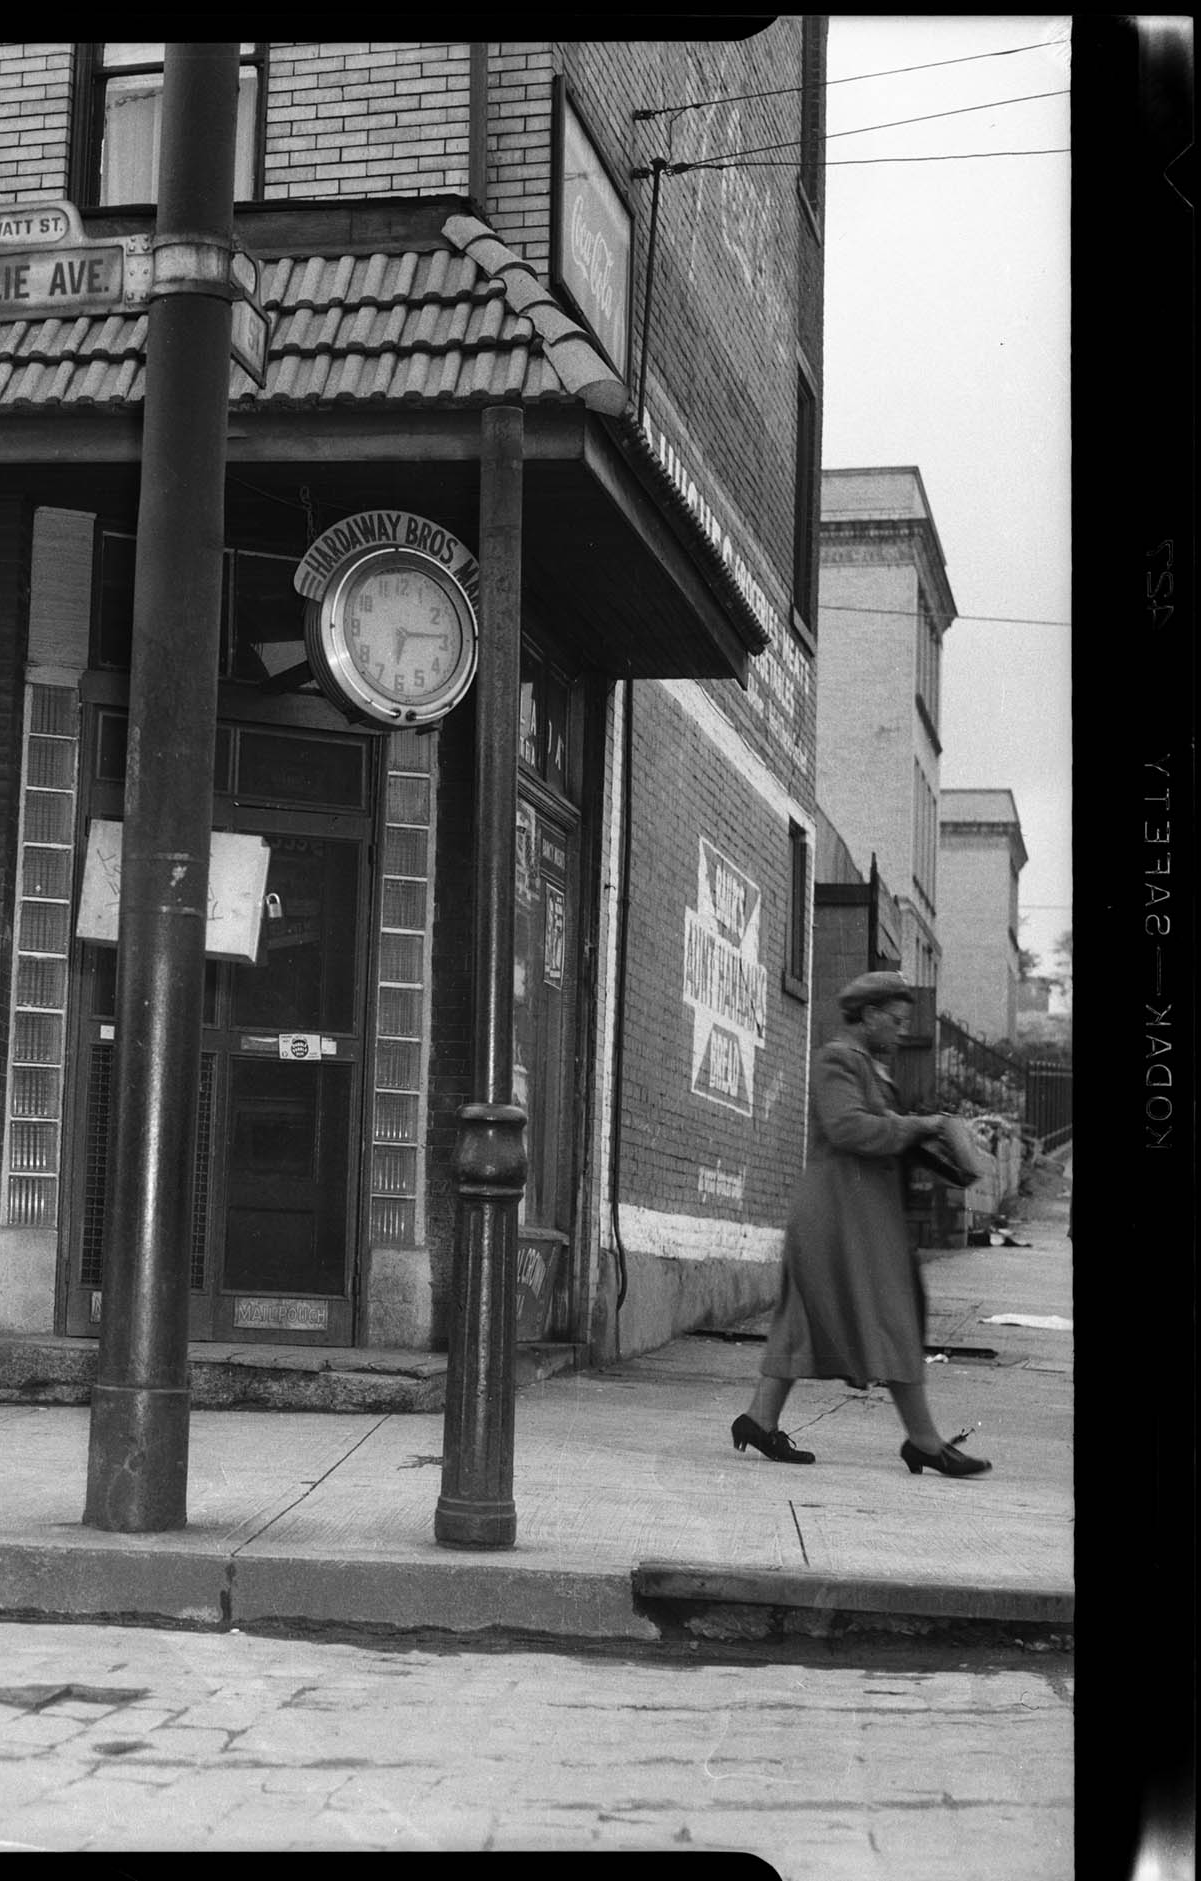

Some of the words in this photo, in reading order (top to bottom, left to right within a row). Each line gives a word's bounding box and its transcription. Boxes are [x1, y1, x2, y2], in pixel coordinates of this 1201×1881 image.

[39, 216, 64, 234] ST.
[48, 258, 110, 298] AVE.
[303, 512, 402, 579] HARDAWAY
[431, 656, 440, 675] 4
[709, 1029, 740, 1097] BREAD
